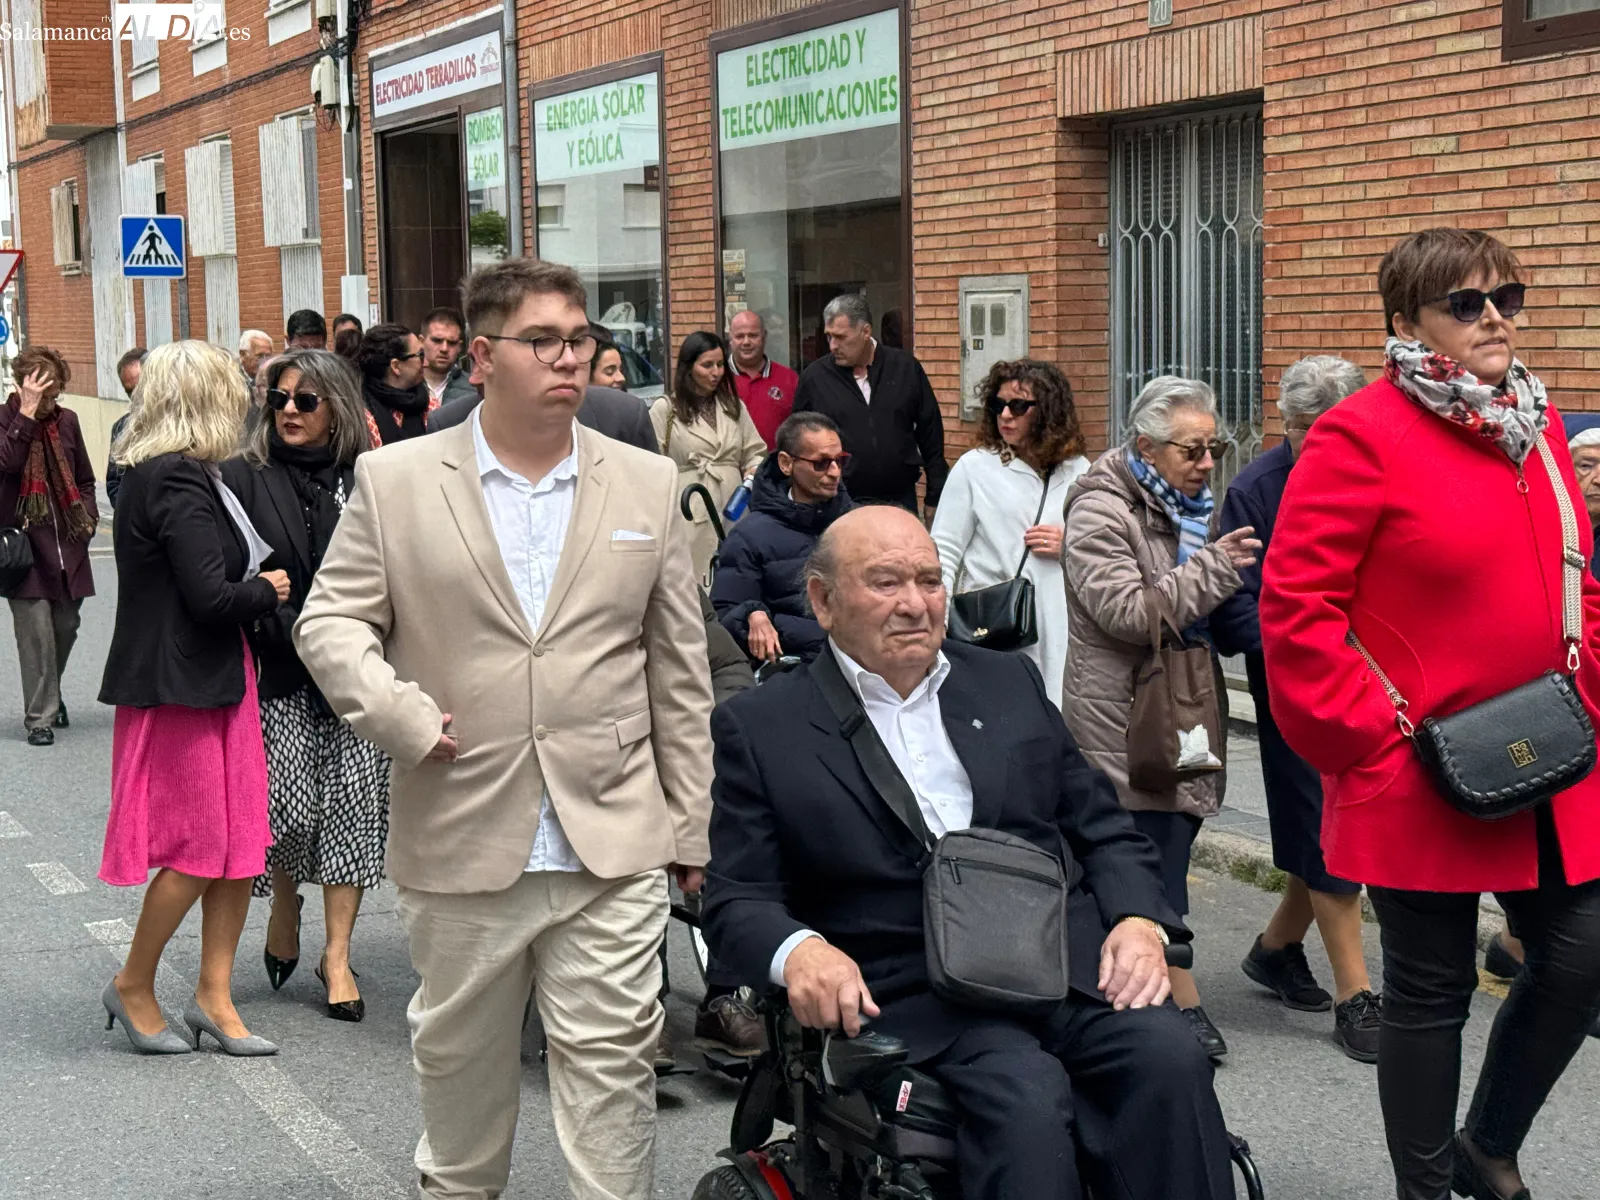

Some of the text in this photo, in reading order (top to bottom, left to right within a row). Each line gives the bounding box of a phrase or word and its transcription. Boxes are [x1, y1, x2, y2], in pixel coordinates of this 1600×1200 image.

[1154, 0, 1167, 22] 20
[747, 27, 867, 88] ELECTRICIDAD Y
[376, 70, 424, 106] ELECTRICIDAD
[425, 53, 477, 91] TERRADILLOS
[603, 84, 645, 121] SOLAR
[722, 74, 898, 139] TELECOMUNICACIONES
[468, 113, 502, 144] BOMBEO
[474, 152, 499, 180] SOLAR
[567, 130, 624, 168] Y EÓLICA
[898, 1084, 909, 1110] APEX
